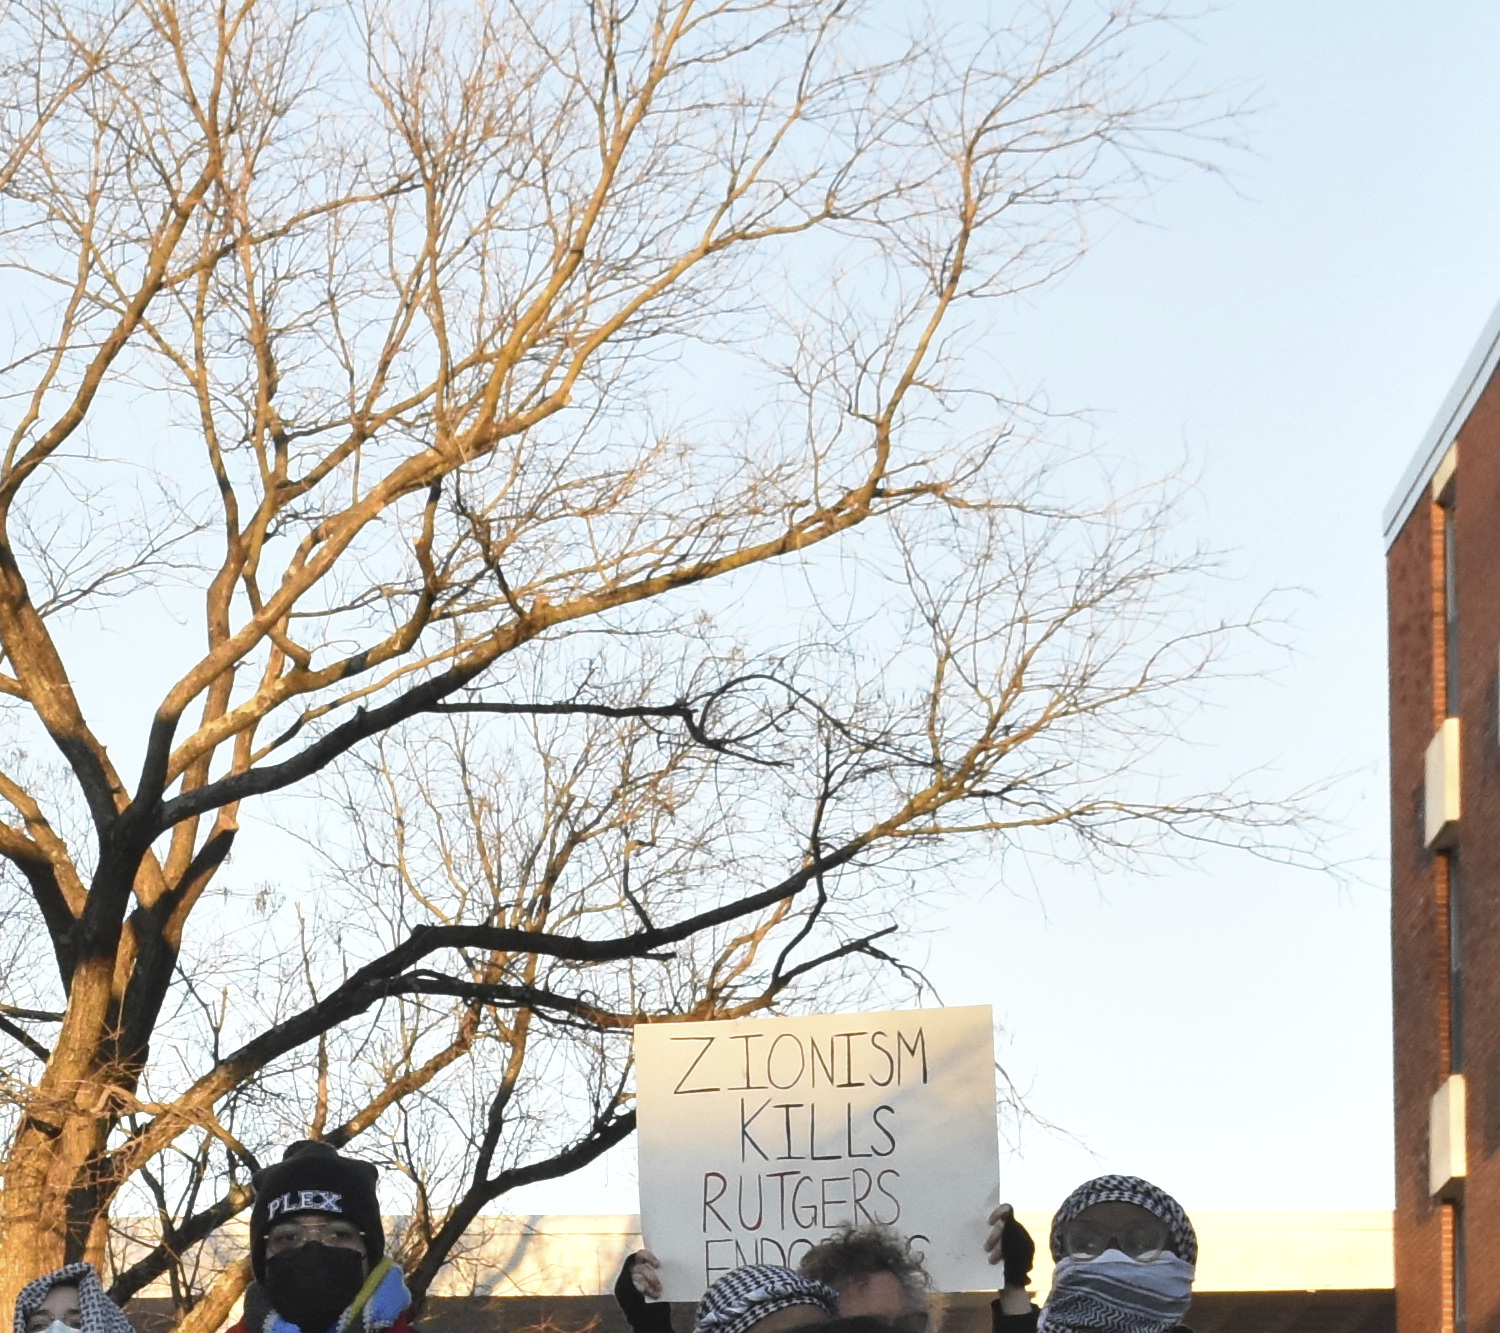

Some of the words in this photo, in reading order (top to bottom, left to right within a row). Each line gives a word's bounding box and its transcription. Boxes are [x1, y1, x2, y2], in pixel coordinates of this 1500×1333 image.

[669, 1027, 929, 1096] ZIONISM
[739, 1097, 897, 1163] KILLS
[267, 1189, 343, 1221] PLEX
[702, 1167, 901, 1234] RUTGERS
